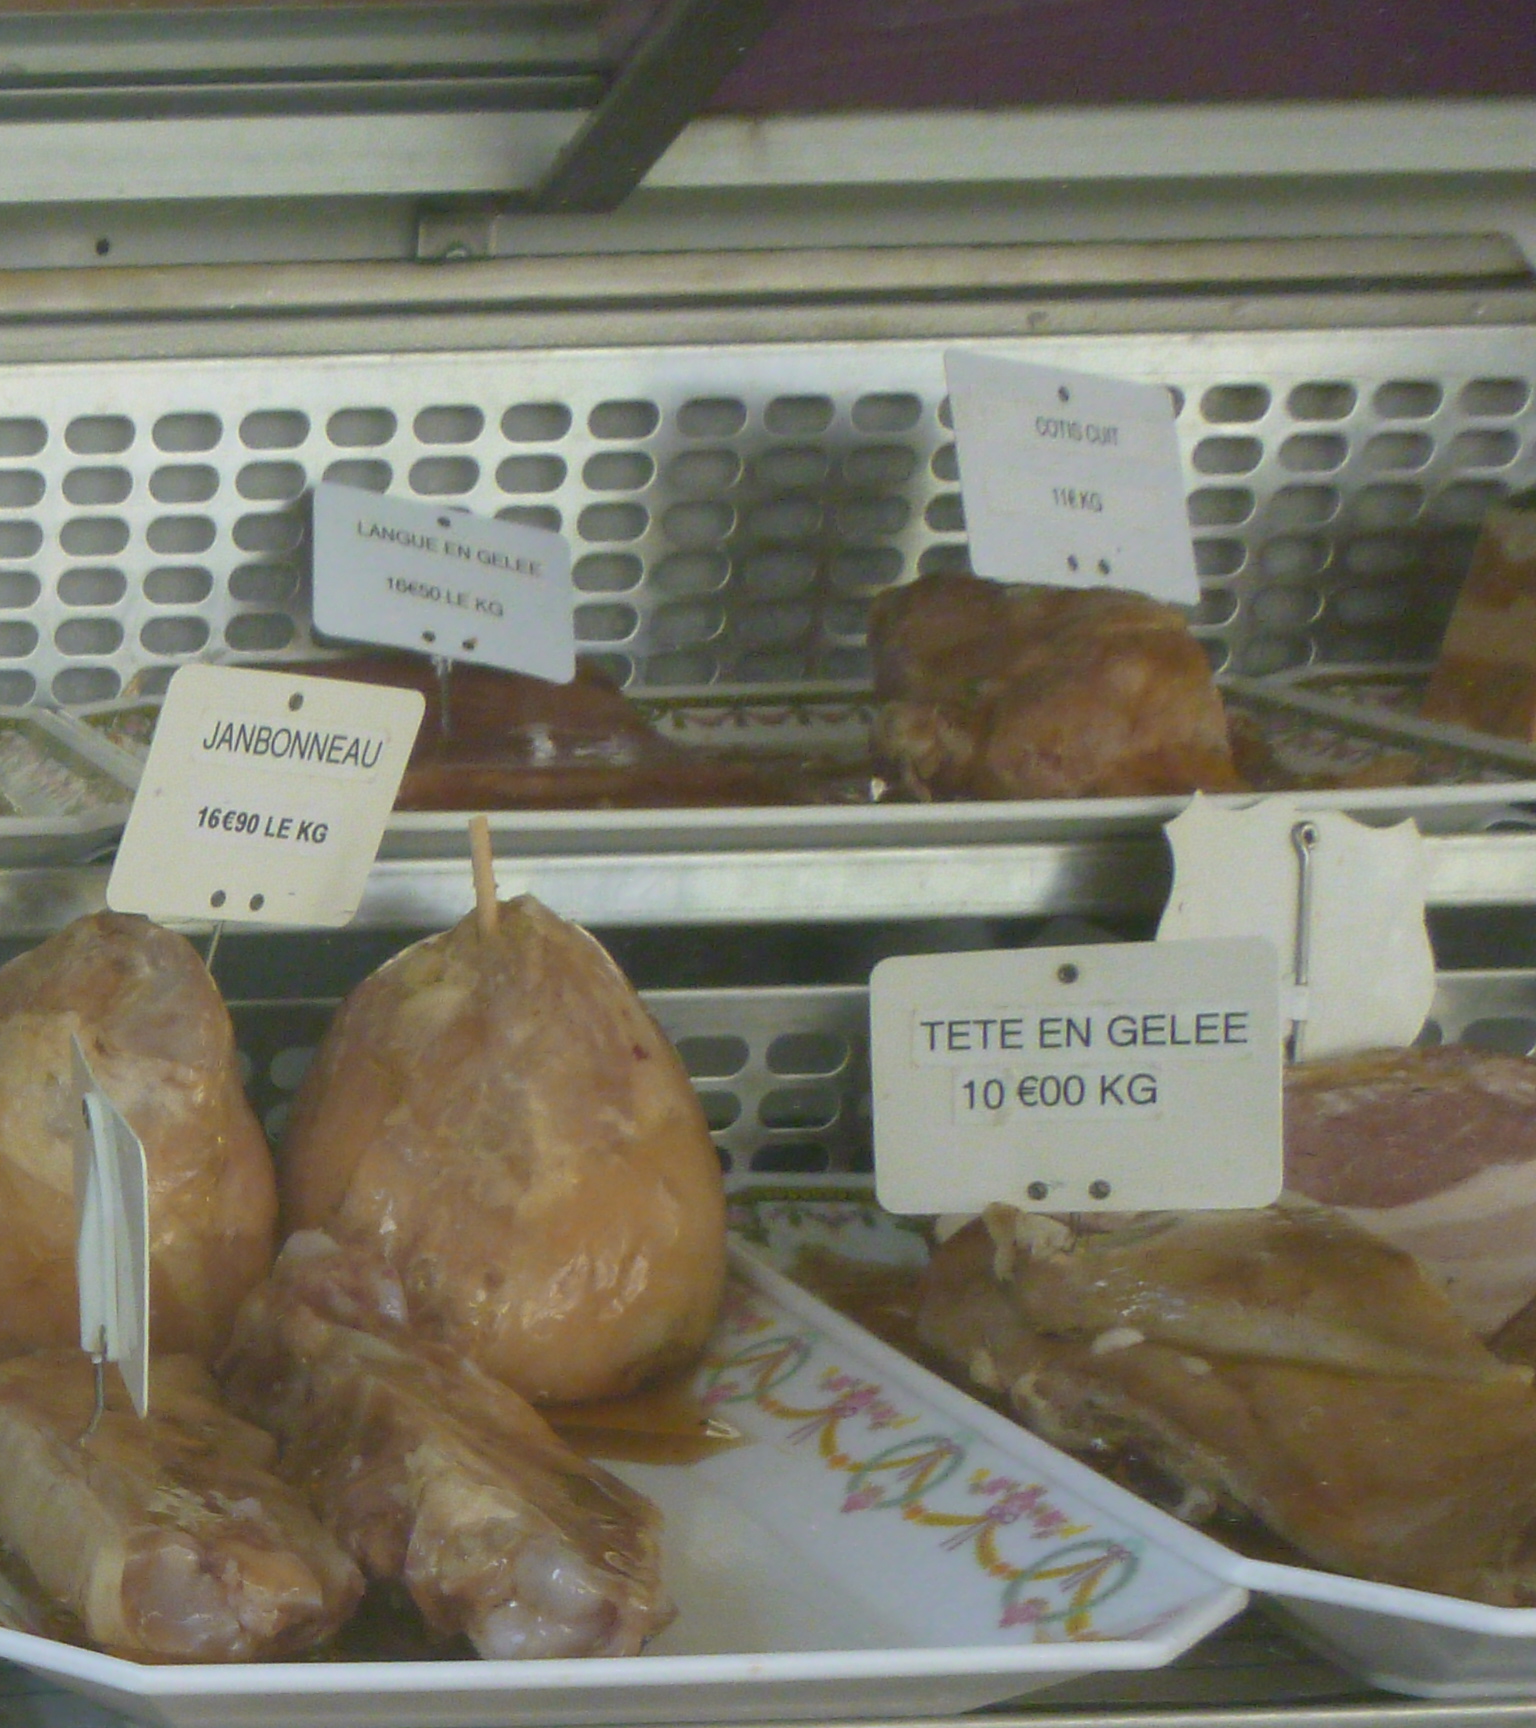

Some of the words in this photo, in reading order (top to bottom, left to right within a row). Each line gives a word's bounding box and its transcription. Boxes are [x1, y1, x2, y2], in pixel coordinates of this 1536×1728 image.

[357, 520, 438, 551] LANGUE
[444, 542, 471, 559] EN
[477, 549, 542, 577] GELEE
[446, 589, 469, 608] LE
[475, 599, 504, 617] KG
[202, 720, 383, 769] JANBONNEAU
[197, 806, 259, 835] 16€90
[264, 816, 291, 839] LE
[297, 820, 329, 845] KG
[919, 1017, 1023, 1052] TETE
[1039, 1016, 1092, 1049] EN
[1107, 1011, 1250, 1047] GELEE
[1099, 1073, 1159, 1106] KG
